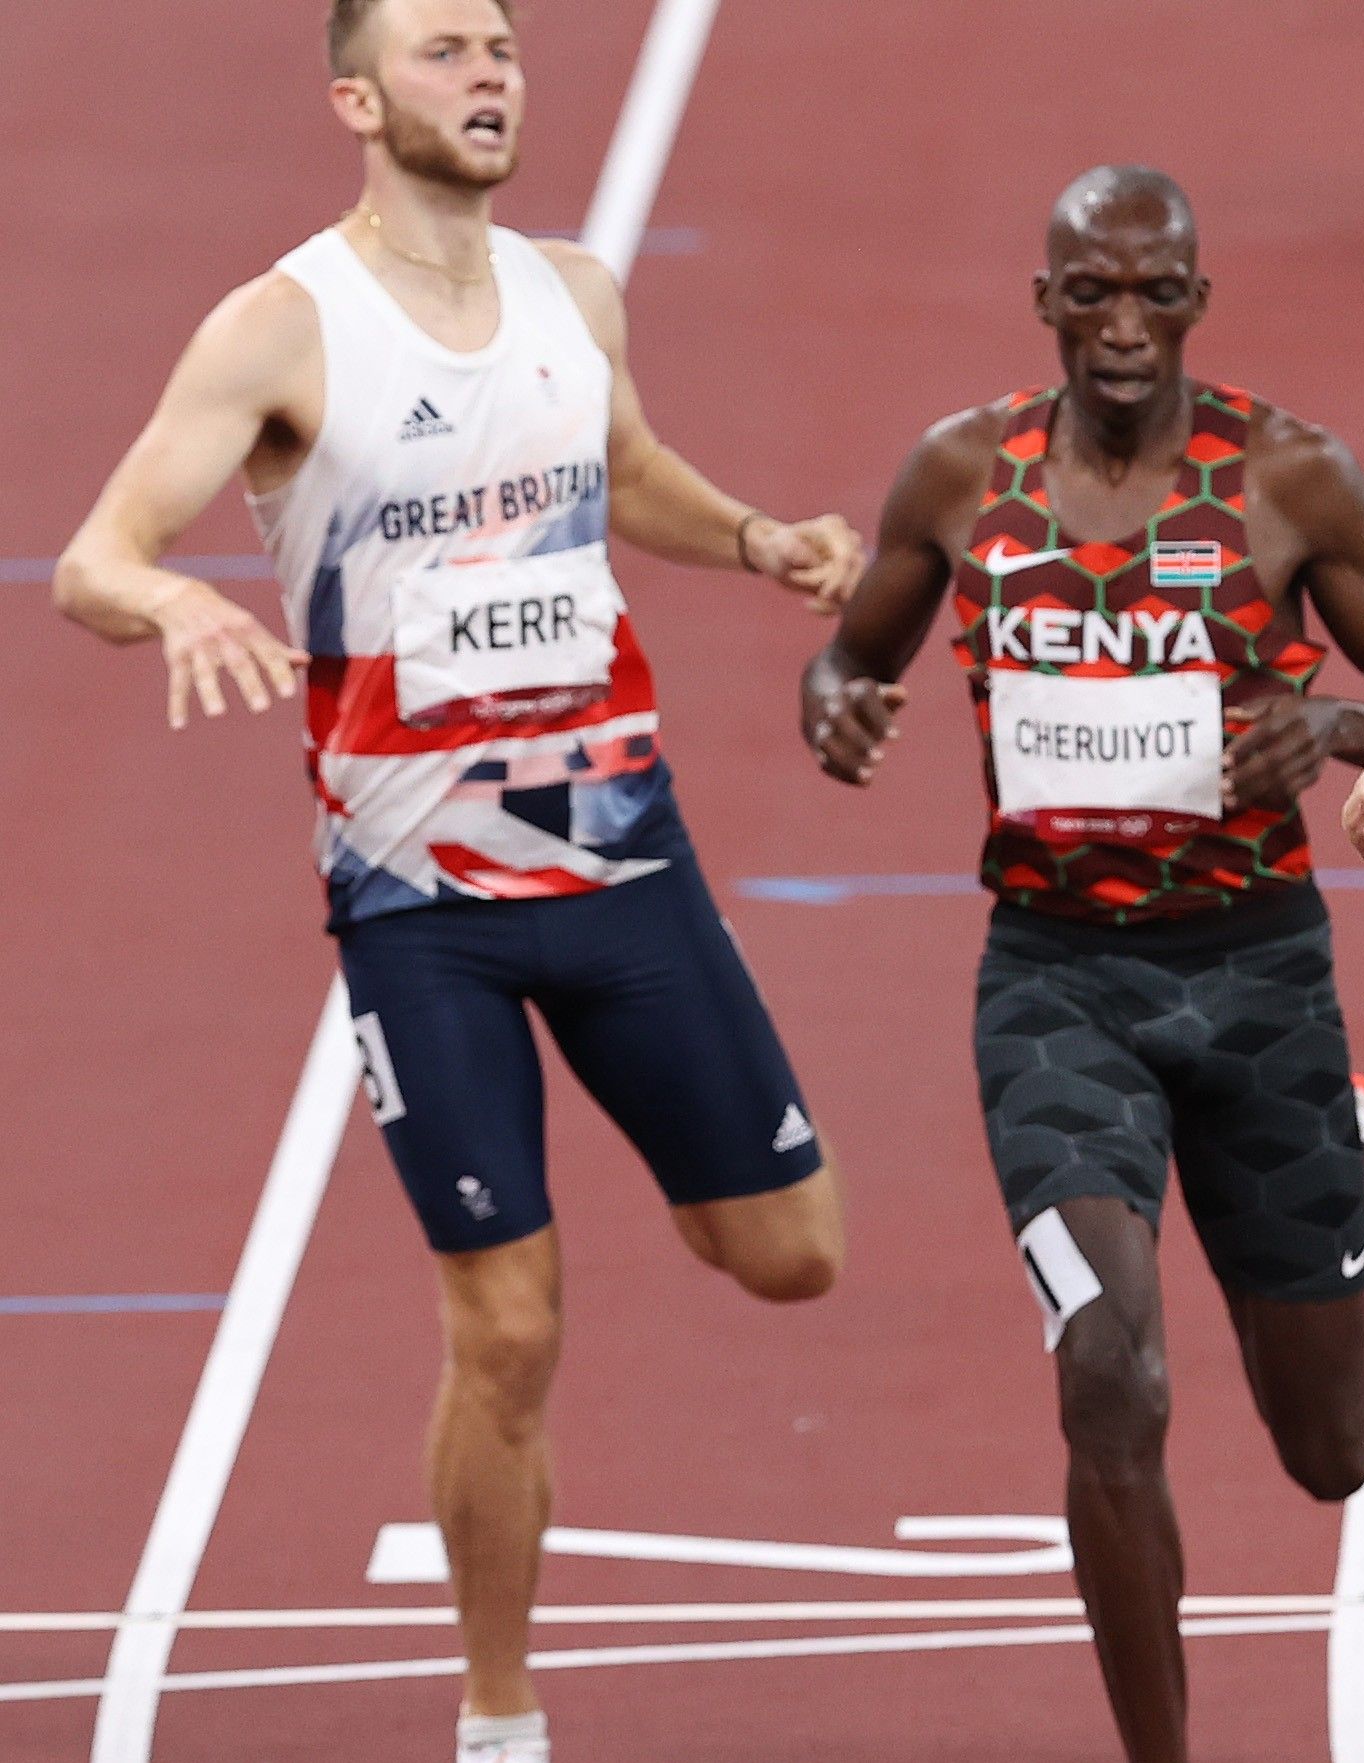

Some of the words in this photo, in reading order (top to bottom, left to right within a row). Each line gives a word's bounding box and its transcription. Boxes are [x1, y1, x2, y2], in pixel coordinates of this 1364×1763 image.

[380, 487, 488, 541] GREAT
[450, 594, 577, 652] KERR
[986, 605, 1217, 665] KENYA
[1015, 718, 1196, 763] CHERUIYOT
